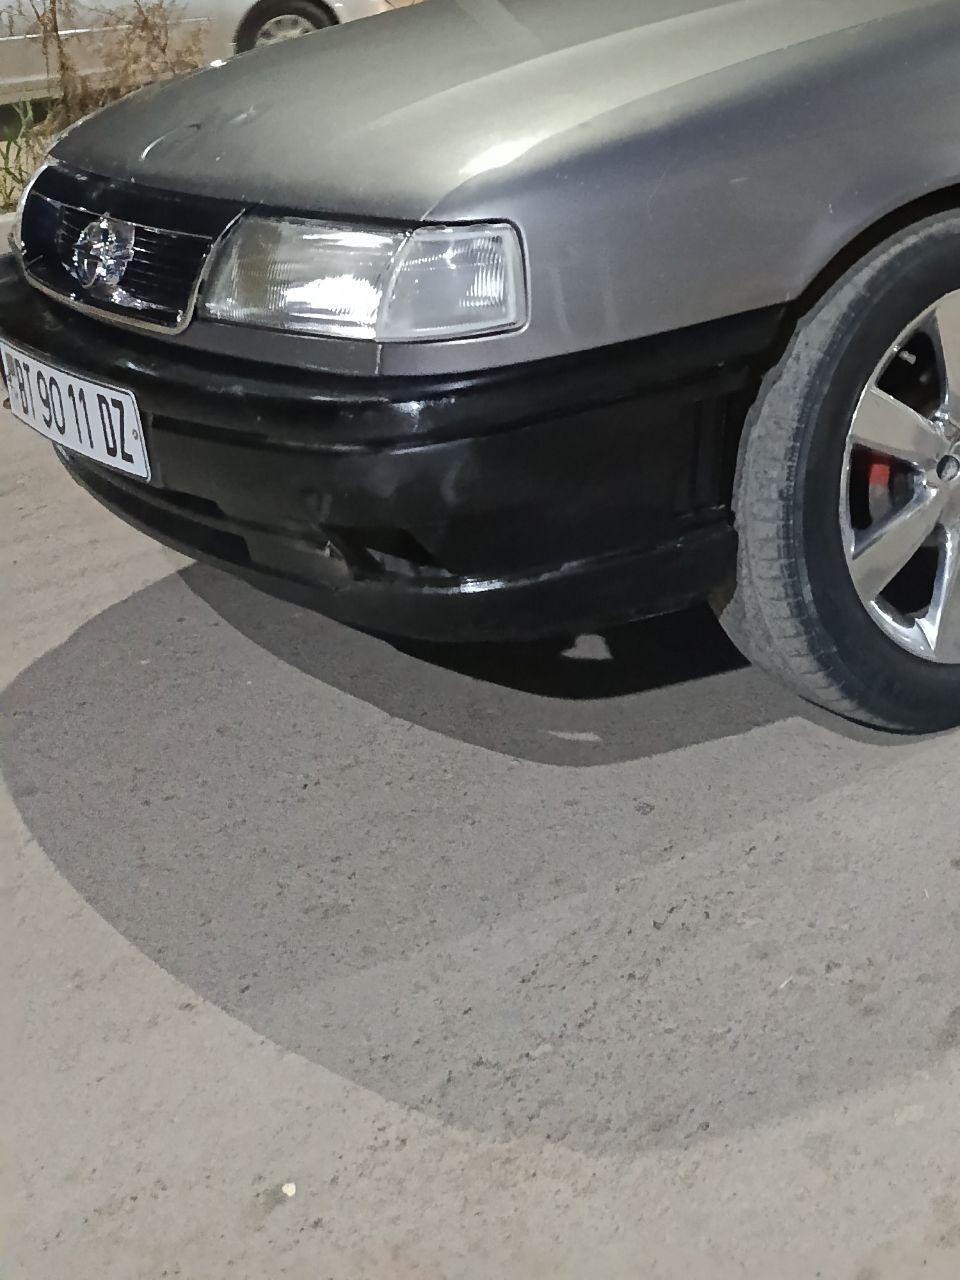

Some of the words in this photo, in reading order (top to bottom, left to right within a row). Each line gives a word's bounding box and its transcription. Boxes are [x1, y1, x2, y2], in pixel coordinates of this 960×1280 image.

[37, 370, 65, 434] 90
[67, 383, 94, 449] 11
[96, 393, 134, 464] DZ
